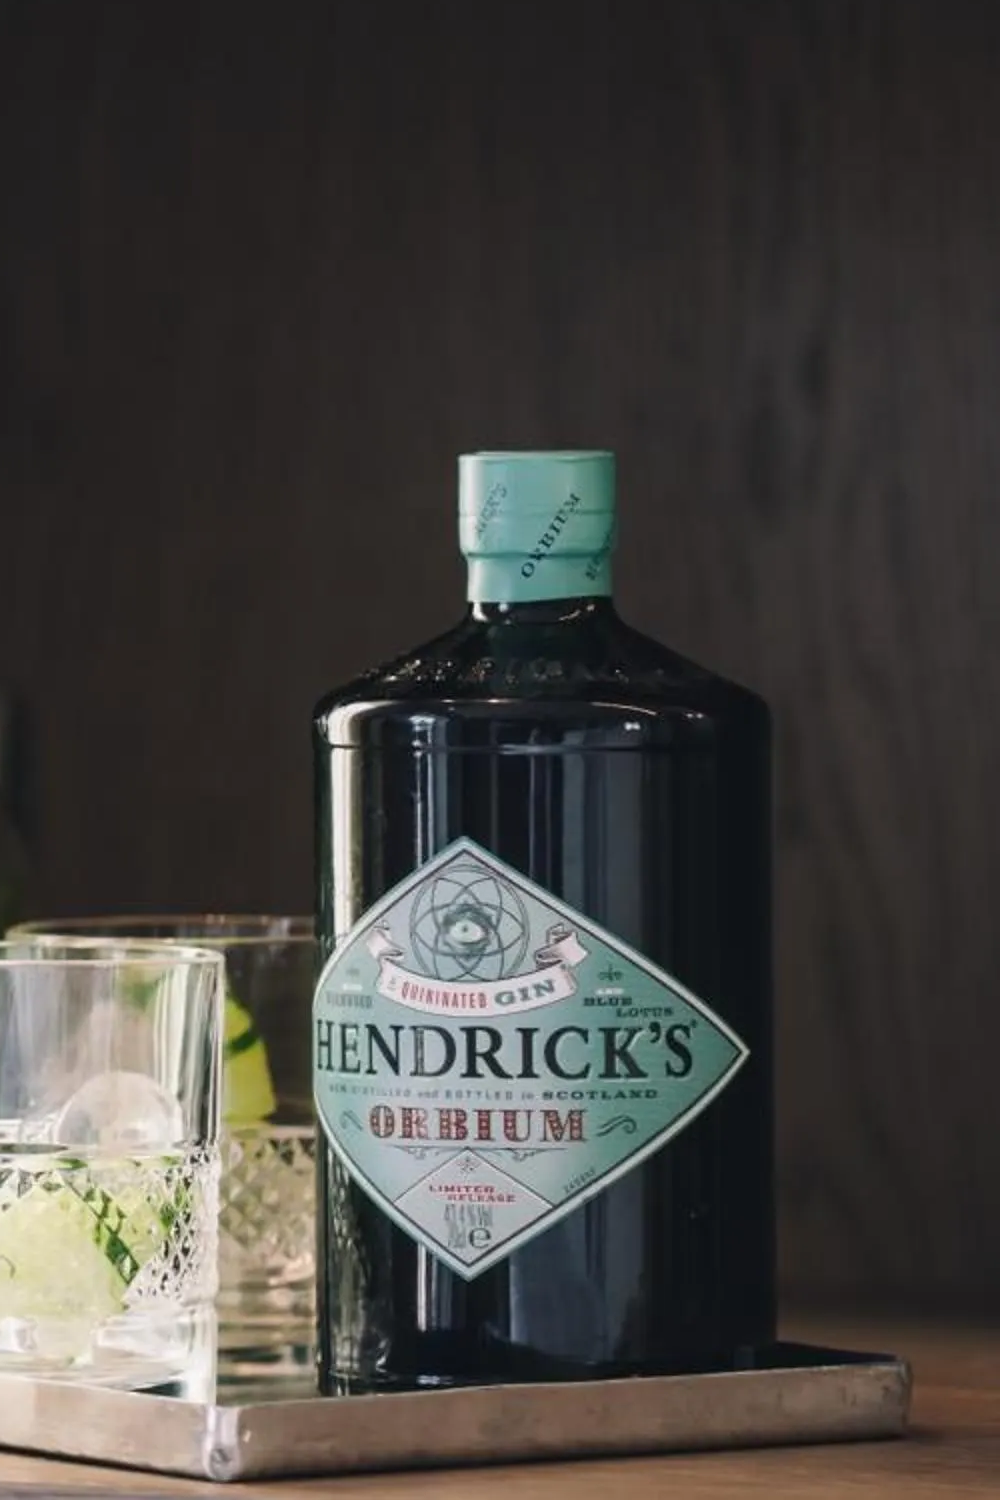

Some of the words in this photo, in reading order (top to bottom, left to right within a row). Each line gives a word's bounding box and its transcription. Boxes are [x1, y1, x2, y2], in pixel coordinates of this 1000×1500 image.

[494, 978, 557, 1006] GIN
[316, 1019, 695, 1080] HENDRICK'S
[542, 1088, 658, 1100] SCOTLAND
[368, 1104, 588, 1143] ORBIUM
[428, 1184, 496, 1193] LIMITED
